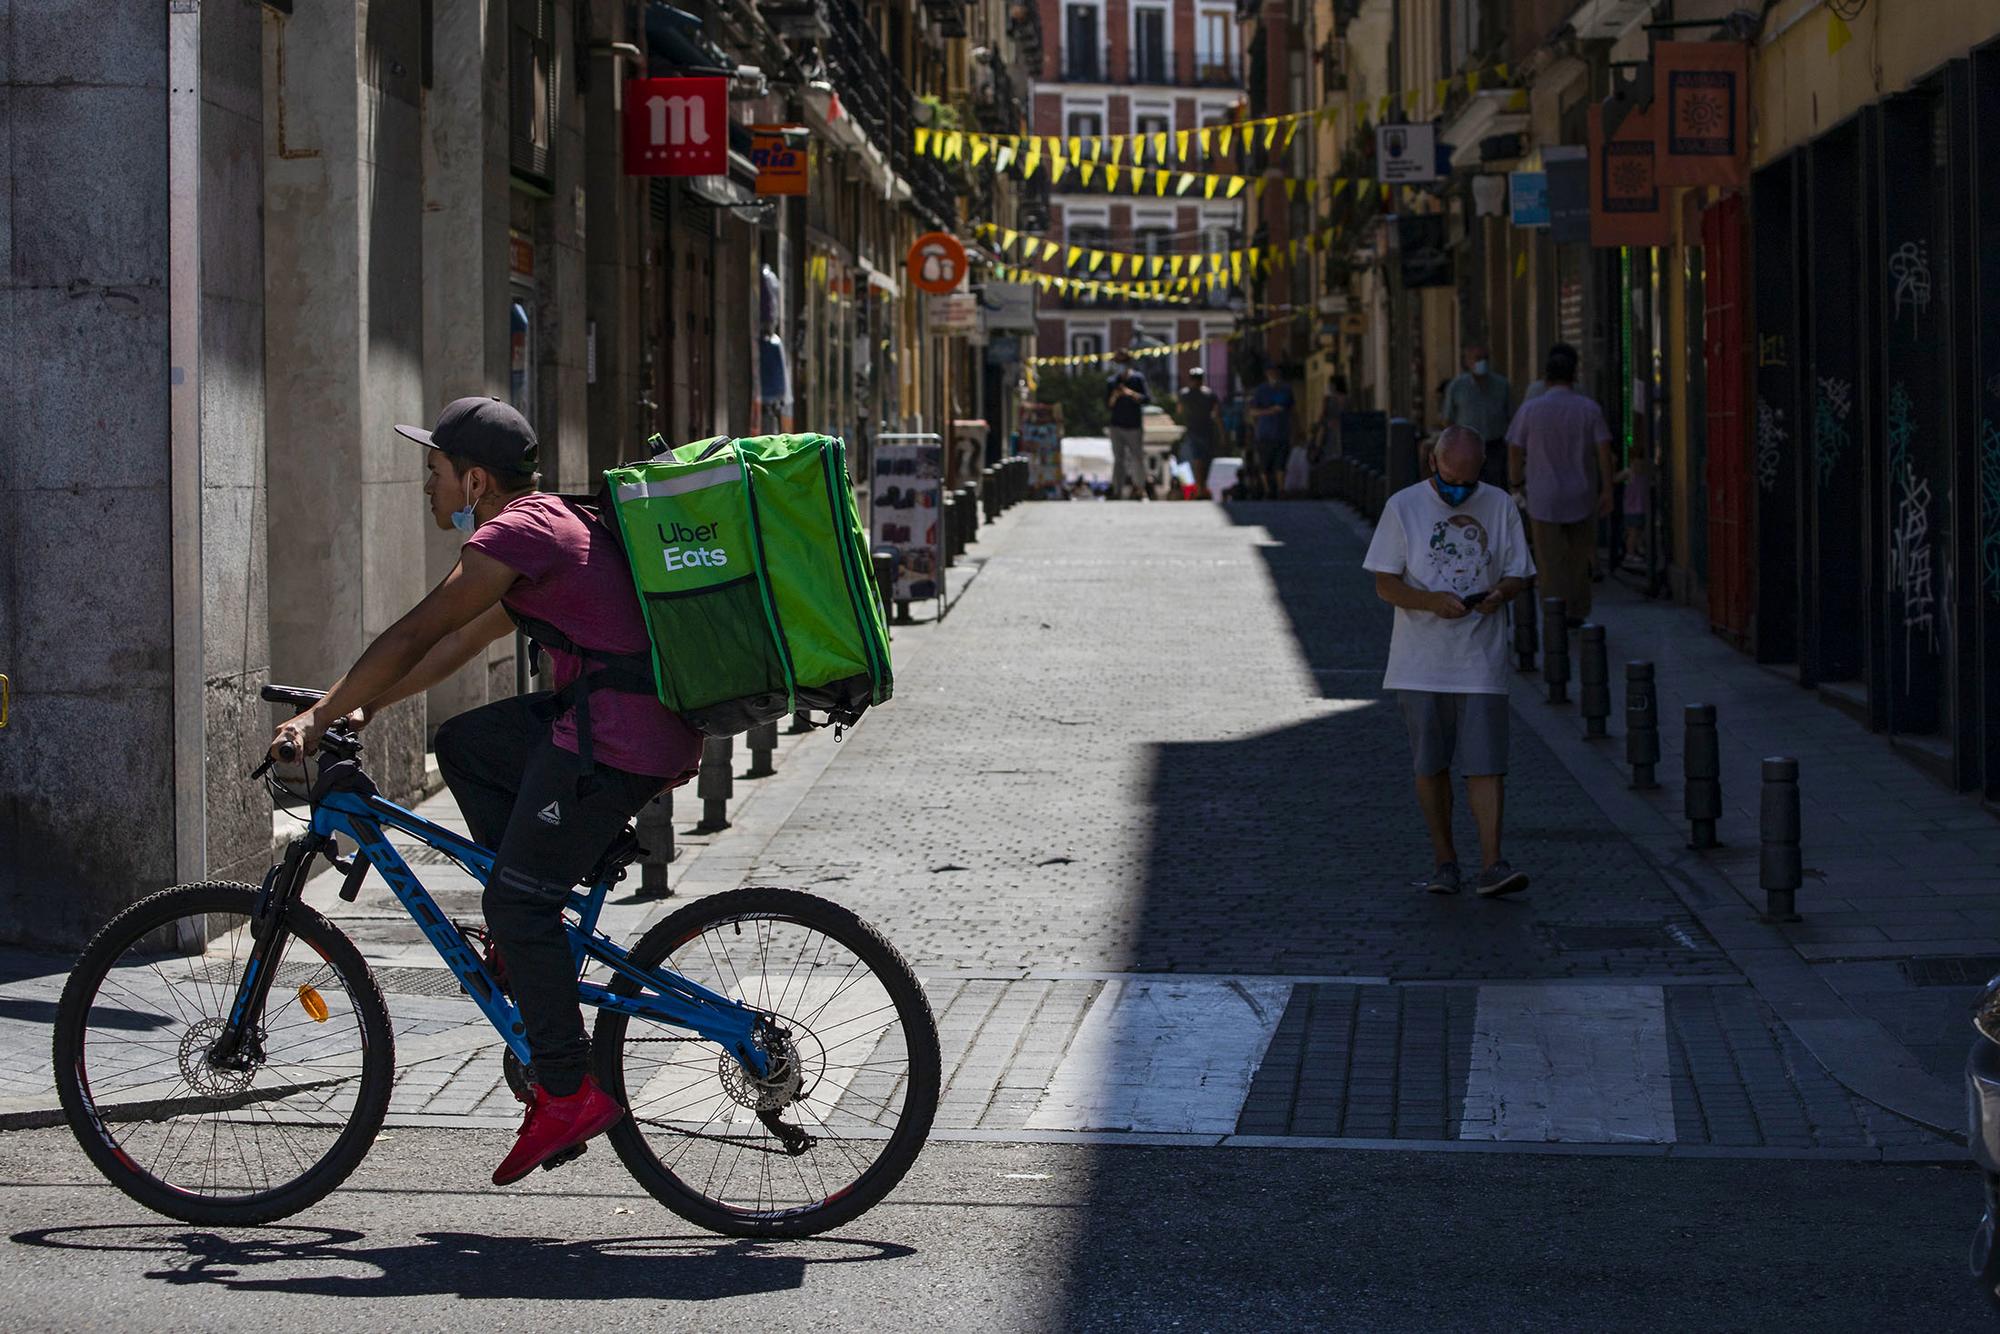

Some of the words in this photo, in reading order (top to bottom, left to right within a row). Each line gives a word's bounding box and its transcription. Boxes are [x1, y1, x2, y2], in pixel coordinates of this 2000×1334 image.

[752, 143, 795, 167] Ria
[657, 521, 719, 544] Uber
[663, 546, 728, 572] Eats
[365, 841, 479, 976] RACER
